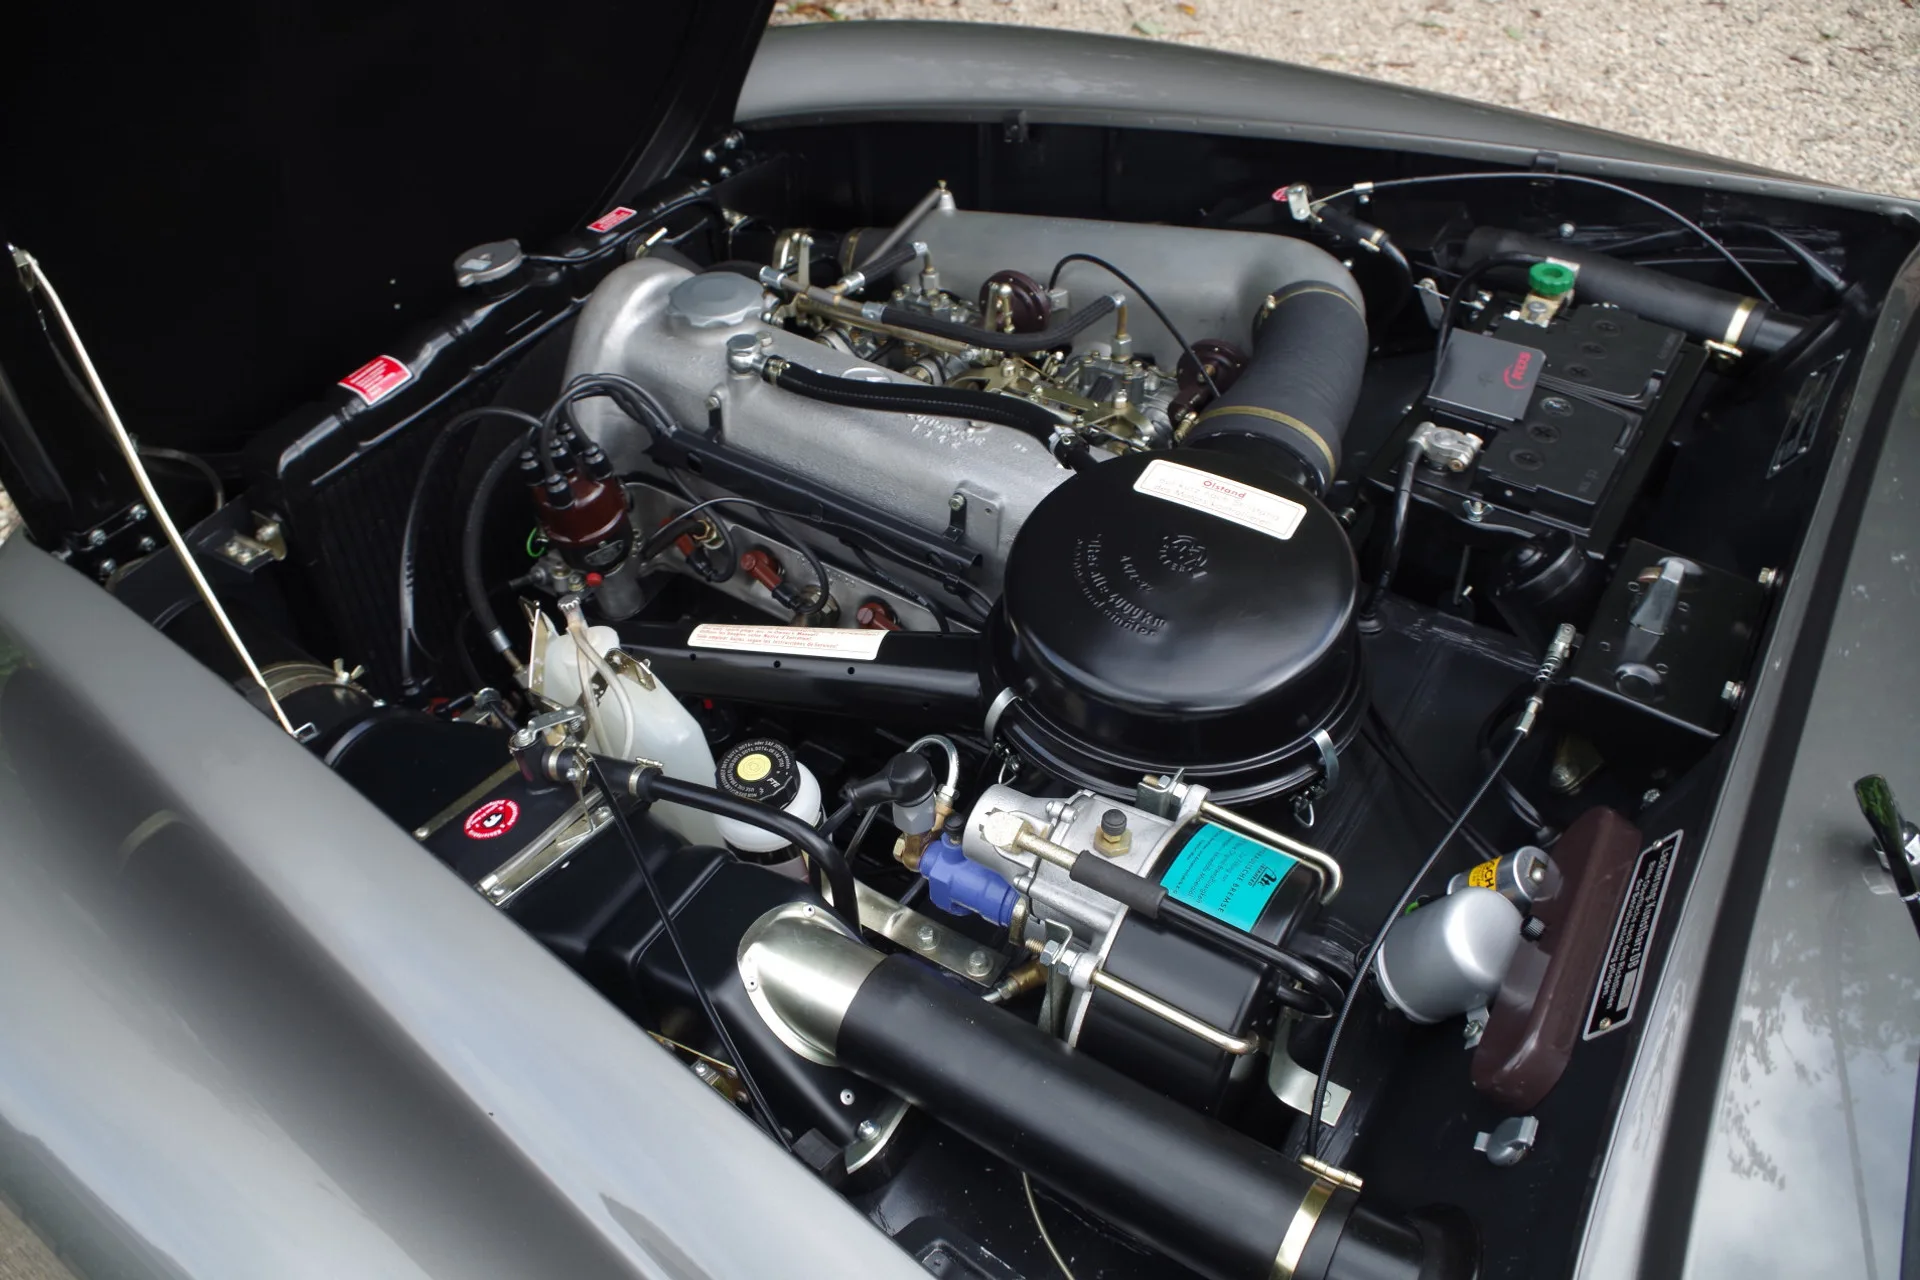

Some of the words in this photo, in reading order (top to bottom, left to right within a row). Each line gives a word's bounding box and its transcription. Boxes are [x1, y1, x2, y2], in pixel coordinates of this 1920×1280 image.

[1203, 479, 1246, 498] Ölstand
[766, 777, 781, 788] FTE
[1217, 883, 1239, 913] BREMSE
[1610, 892, 1640, 963] Betriebsanleitung
[1624, 923, 1635, 944] nach
[1631, 902, 1656, 953] Kunstharz
[1619, 944, 1630, 961] den
[1627, 953, 1641, 969] DB
[1606, 960, 1625, 1009] Richtlinien
